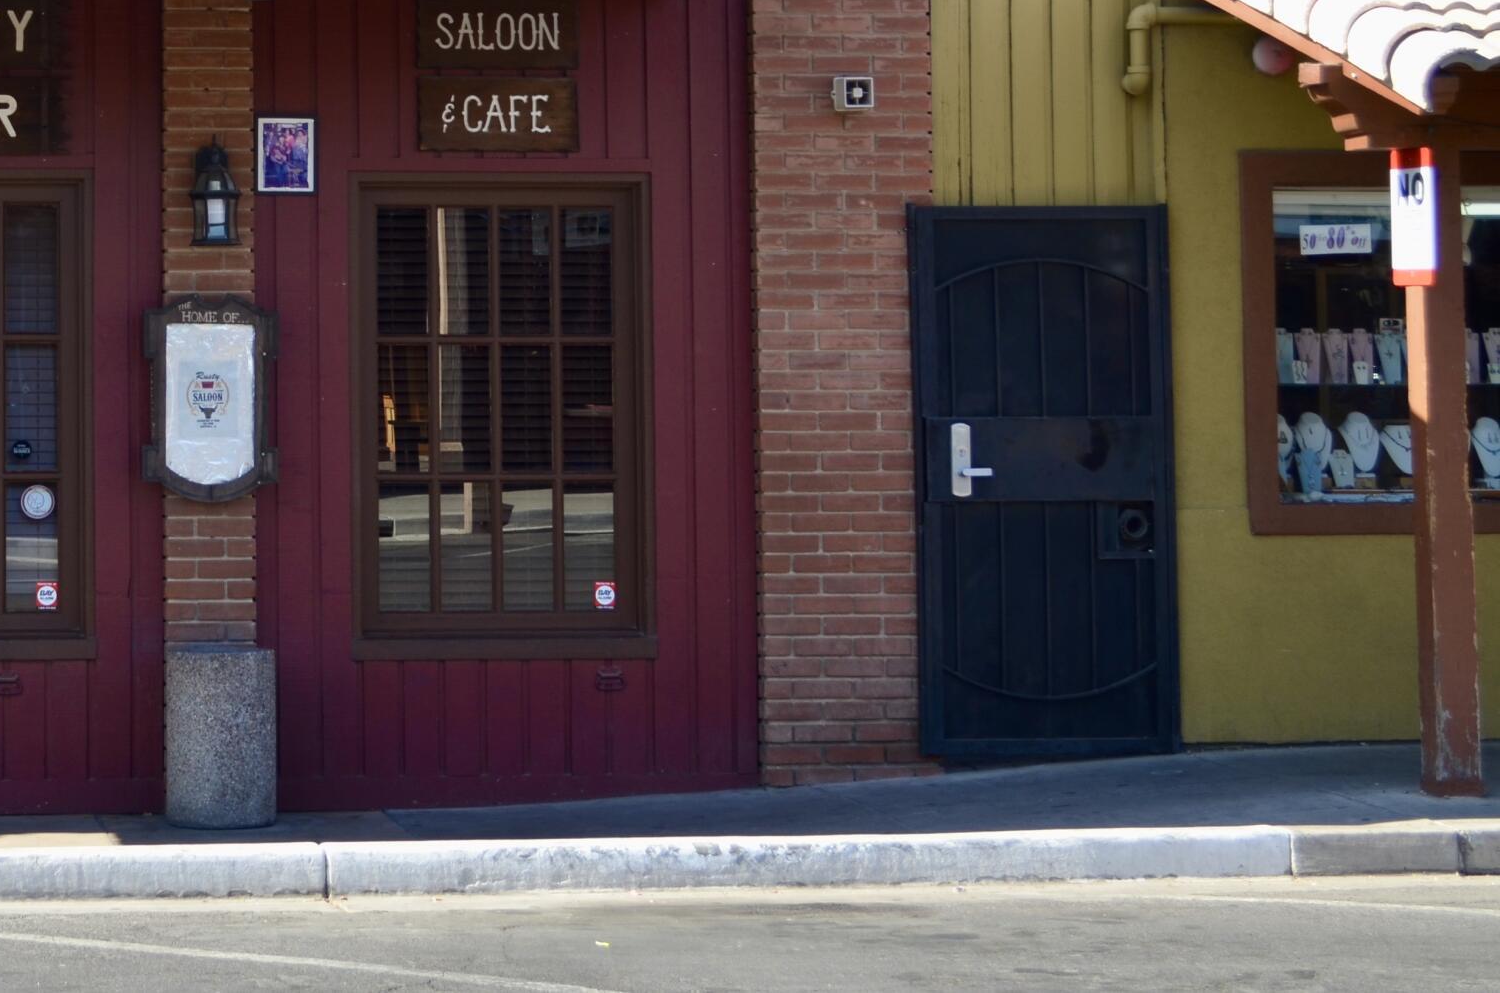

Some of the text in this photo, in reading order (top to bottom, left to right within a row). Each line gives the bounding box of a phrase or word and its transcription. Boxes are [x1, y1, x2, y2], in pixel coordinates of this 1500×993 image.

[435, 12, 561, 51] SALOON
[462, 94, 552, 133] CAFE
[1397, 172, 1424, 206] NO
[178, 301, 192, 311] THE
[181, 310, 218, 323] HOME
[196, 371, 220, 380] Rusty
[192, 392, 222, 402] SALOON
